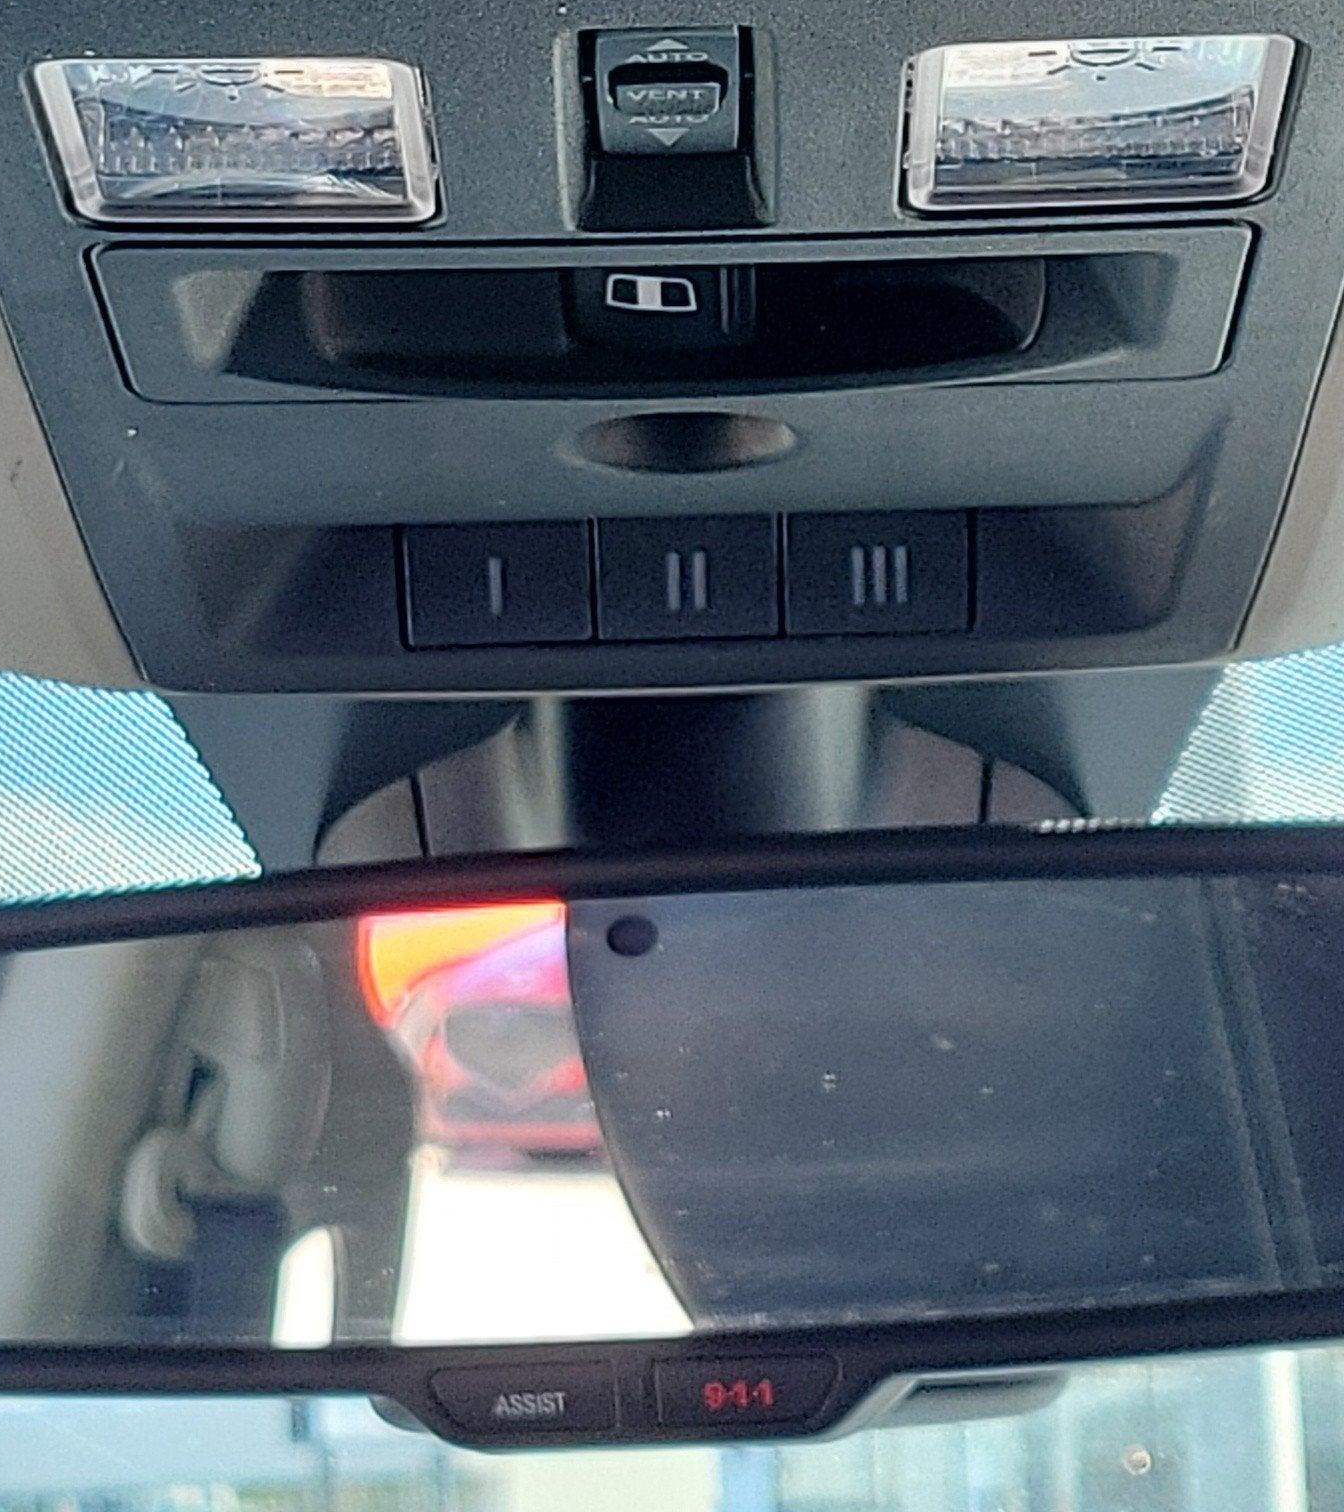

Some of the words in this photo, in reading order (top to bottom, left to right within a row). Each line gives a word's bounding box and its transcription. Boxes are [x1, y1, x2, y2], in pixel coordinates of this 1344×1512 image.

[624, 52, 708, 63] AUTO
[626, 90, 706, 101] VENT
[495, 1391, 566, 1418] ASSIST
